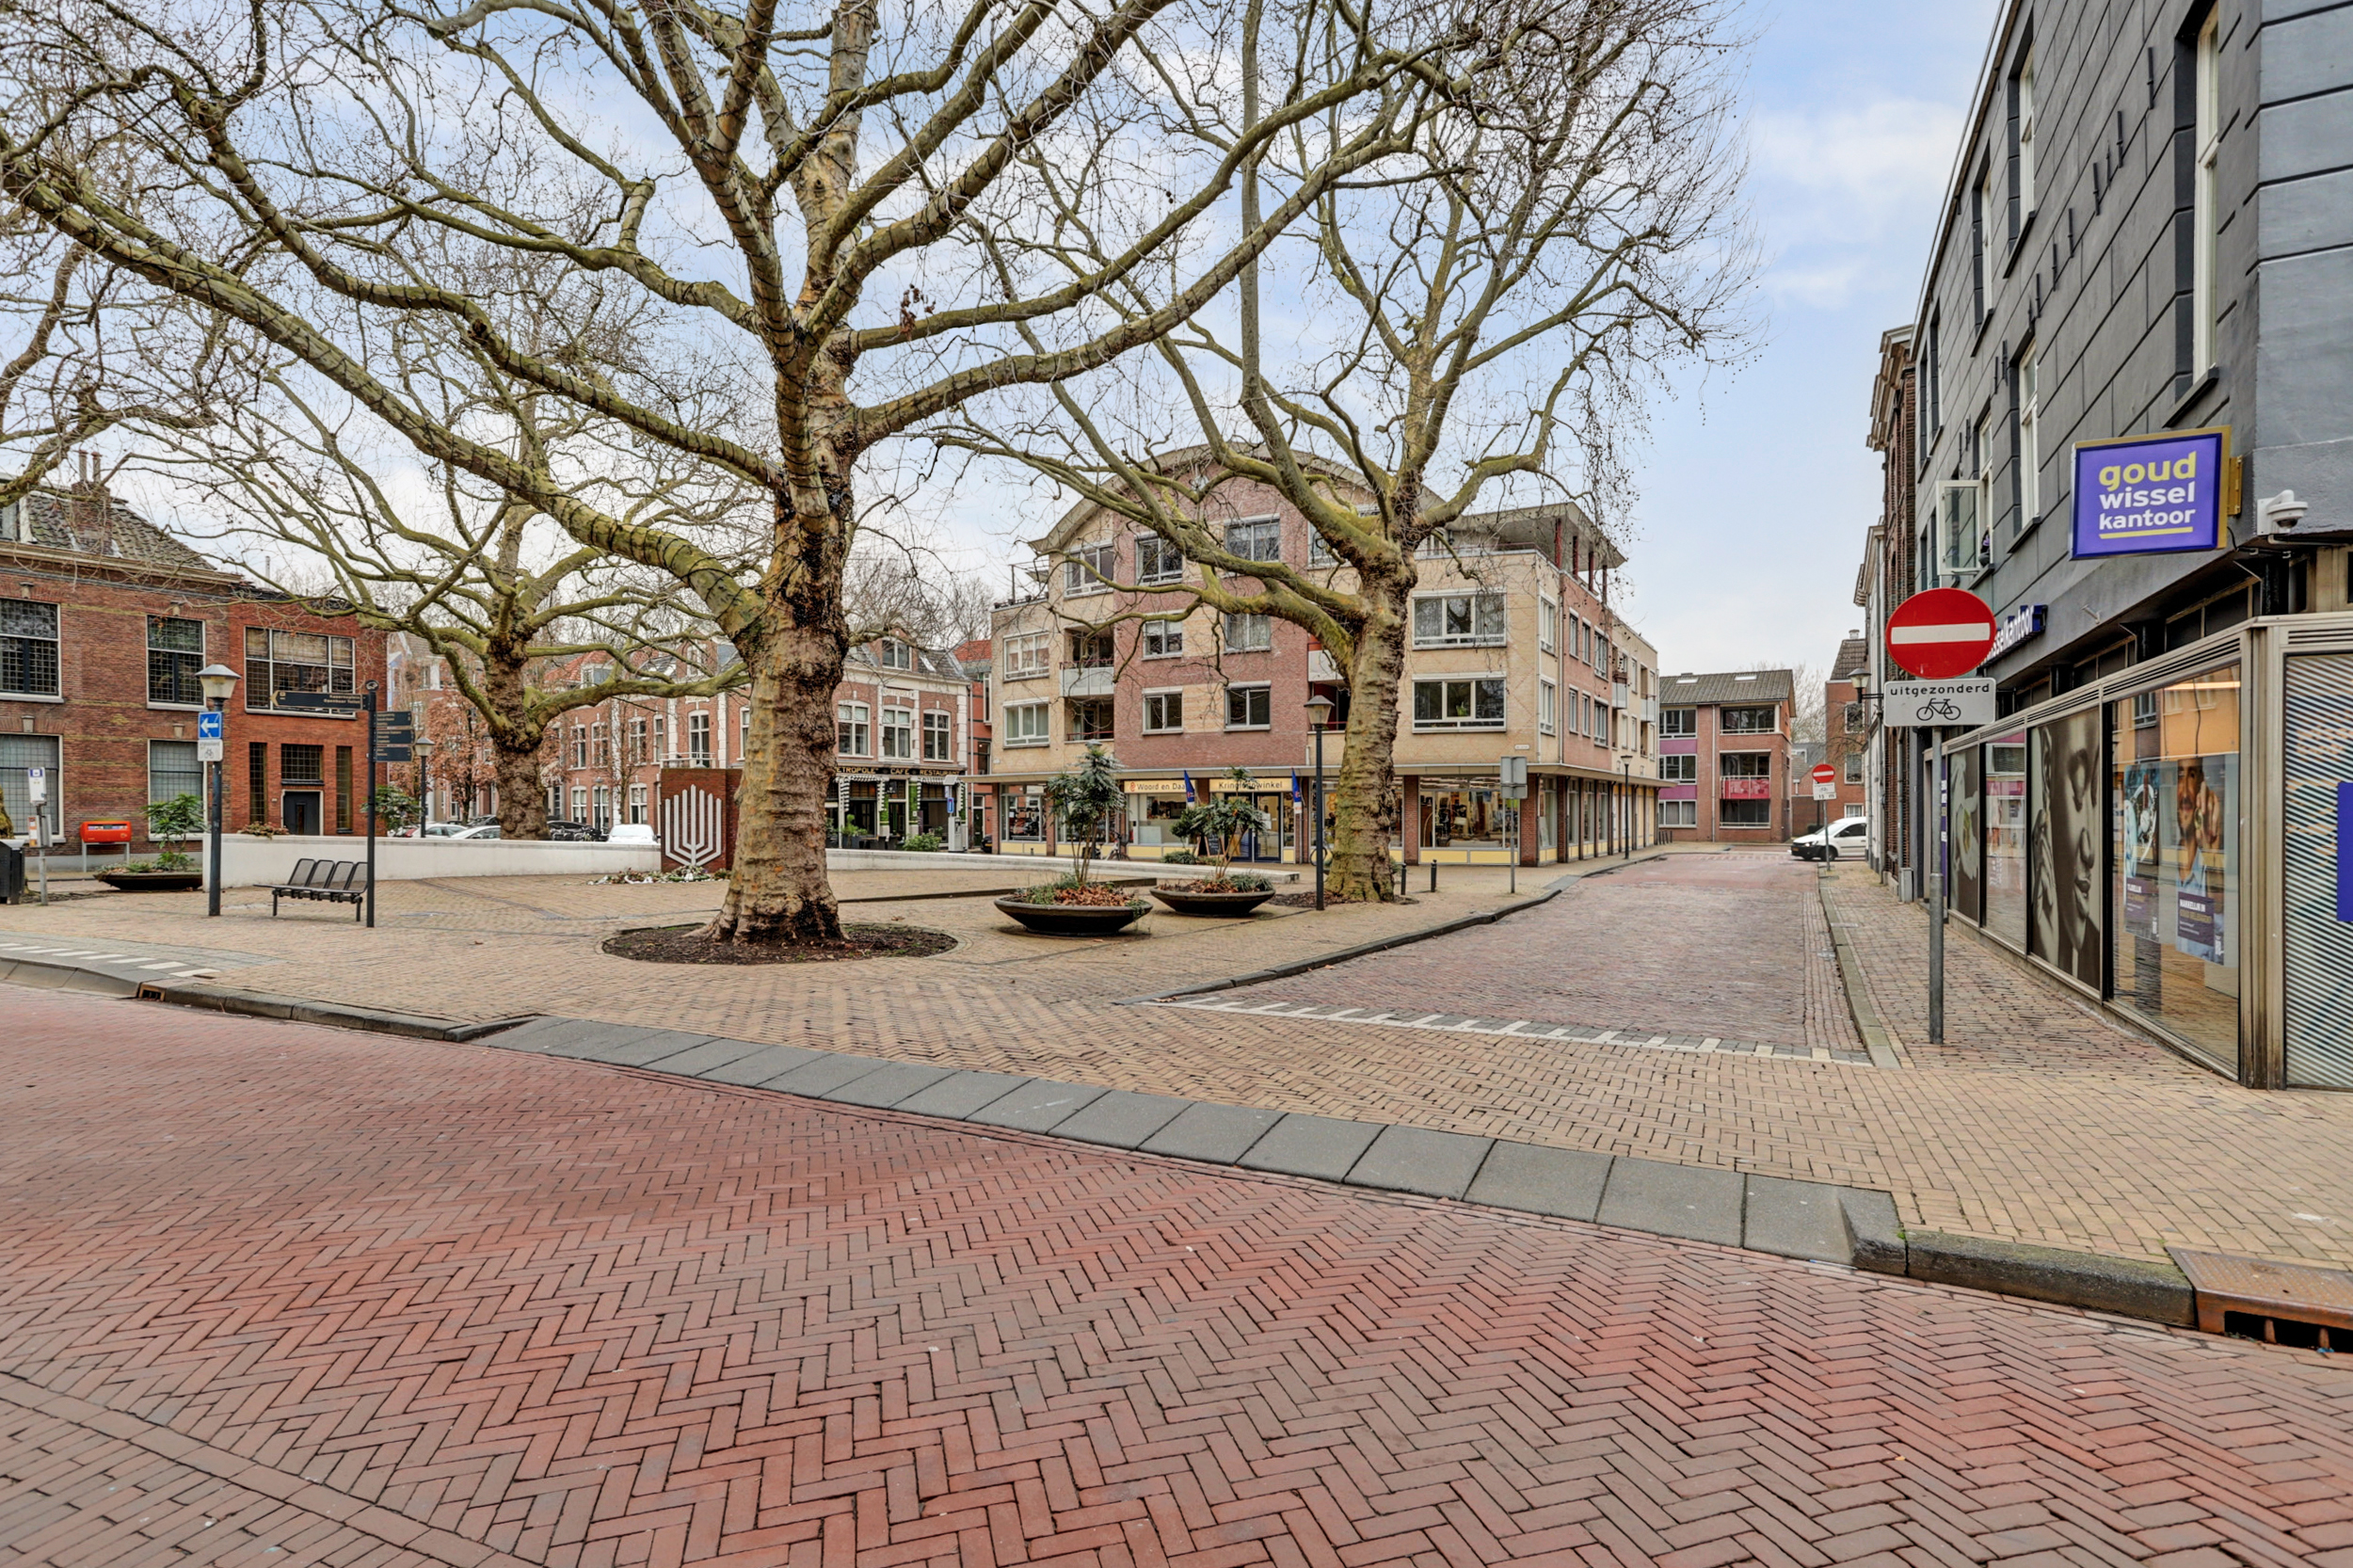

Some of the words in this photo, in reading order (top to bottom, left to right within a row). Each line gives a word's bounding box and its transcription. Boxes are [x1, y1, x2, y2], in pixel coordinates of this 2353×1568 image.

[2099, 451, 2197, 492] goud
[2099, 481, 2196, 509] wissel
[2099, 509, 2196, 530] kantoor
[1890, 683, 1990, 697] uitgezonderd
[1219, 781, 1283, 791] Krinlpwinkel
